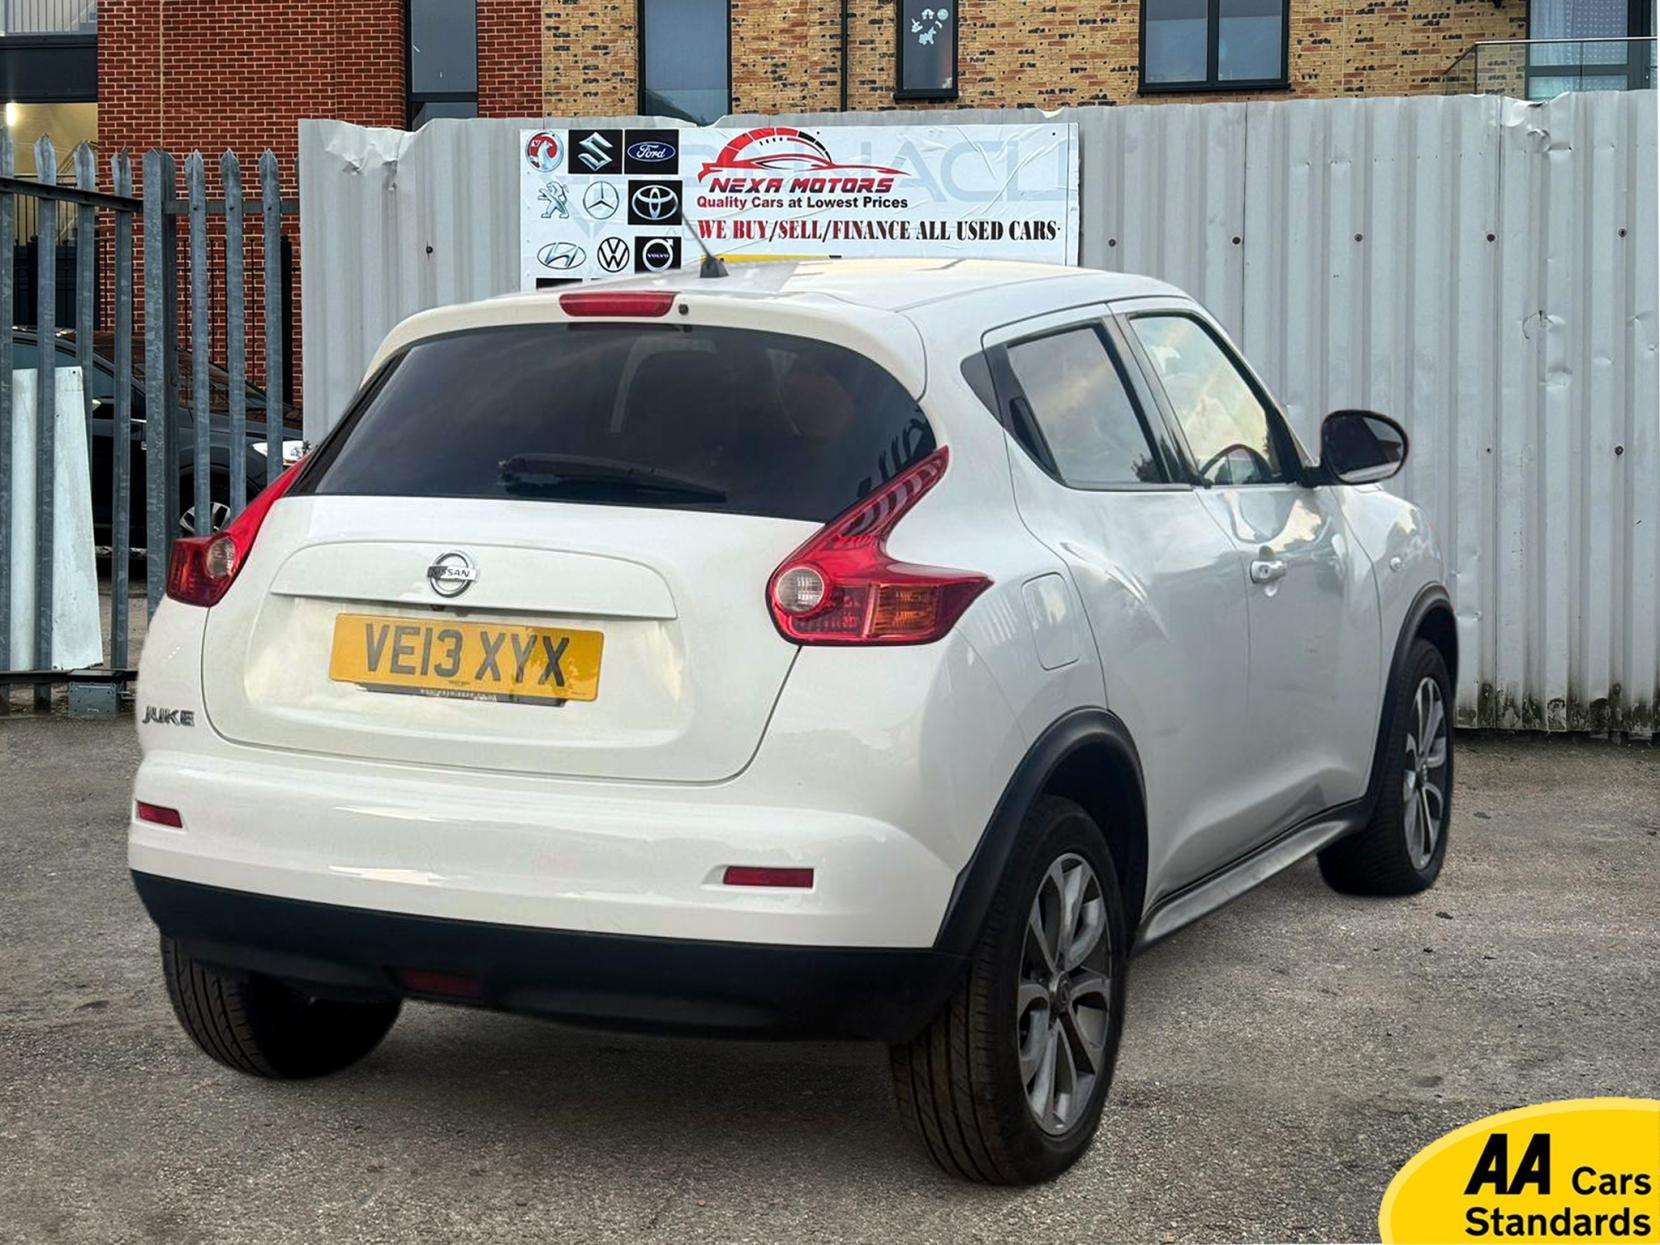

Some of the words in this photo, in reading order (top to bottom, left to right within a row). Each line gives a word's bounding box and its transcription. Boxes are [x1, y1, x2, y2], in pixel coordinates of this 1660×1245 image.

[636, 144, 666, 159] Ford
[709, 177, 782, 193] NEXA
[789, 177, 895, 194] MOTORS
[696, 195, 748, 213] Quality
[751, 195, 784, 210] Cars
[788, 196, 803, 210] at
[806, 196, 859, 210] Lowest
[862, 196, 909, 210] Prices
[695, 219, 728, 241] WE
[733, 219, 911, 244] BUY/SELL/FINANCE
[915, 219, 951, 241] ALL
[956, 219, 1004, 241] USED
[364, 623, 462, 677] VE13
[474, 630, 571, 688] XYX
[142, 705, 195, 727] JUKE
